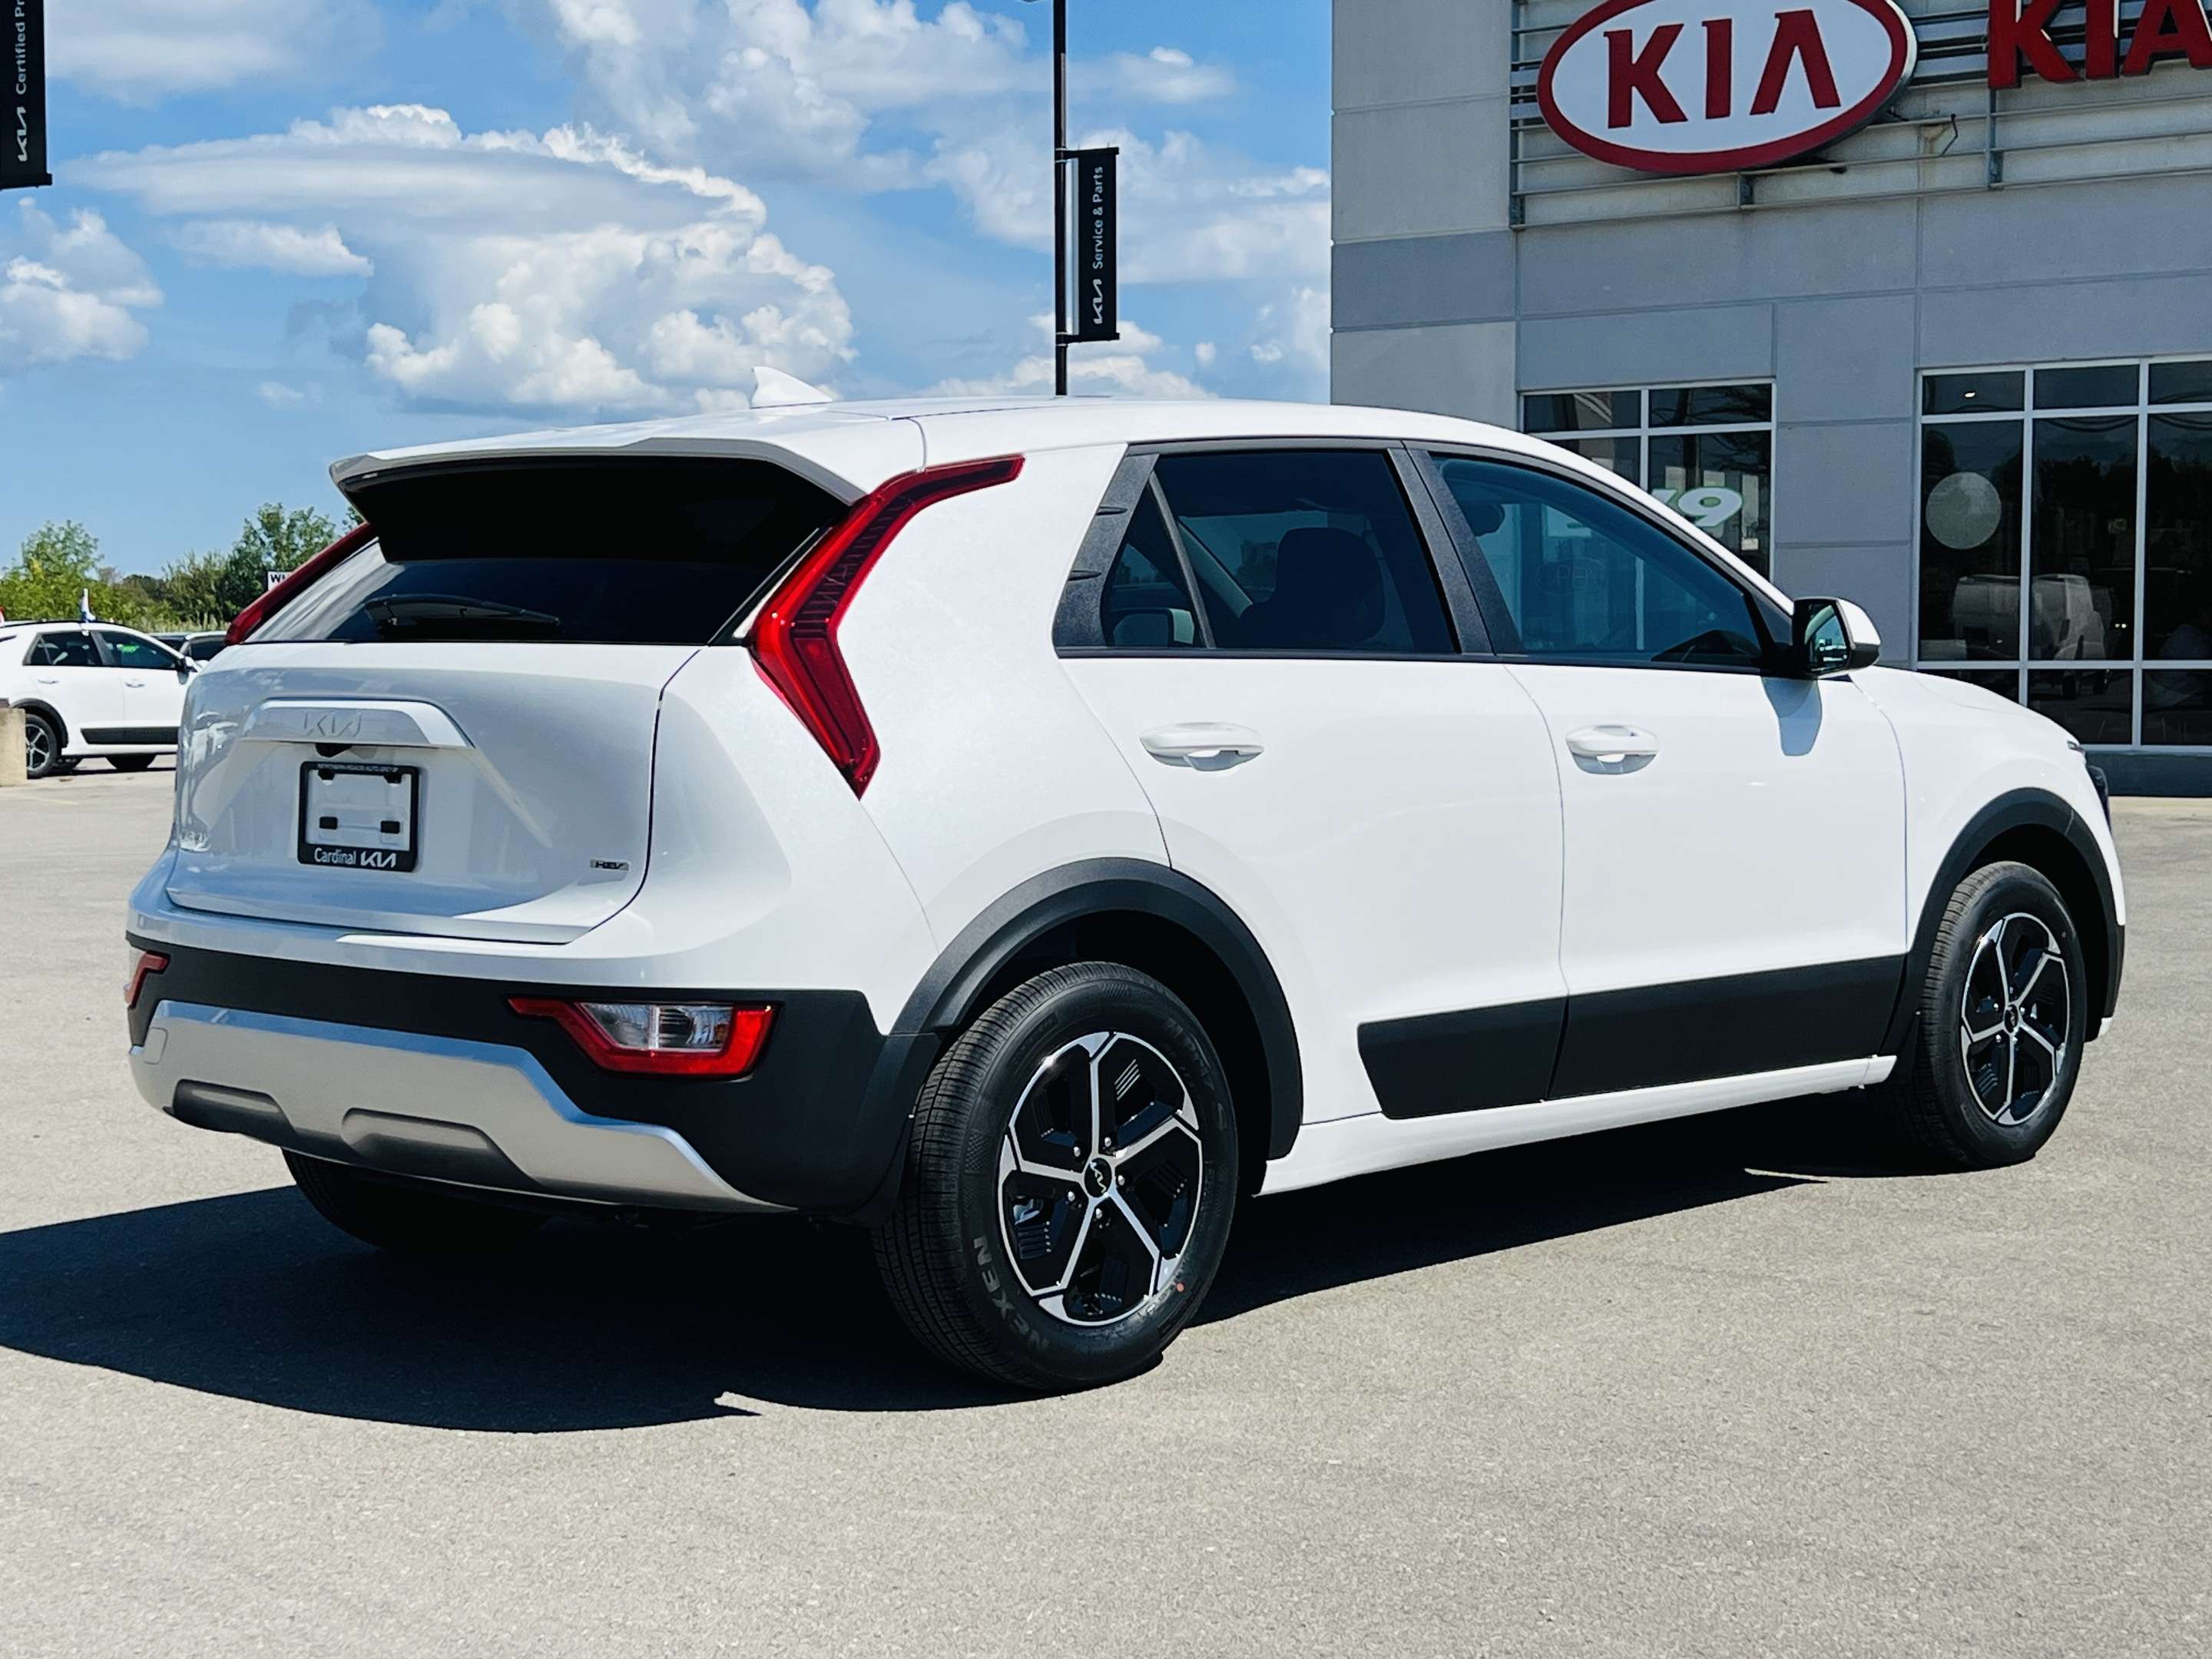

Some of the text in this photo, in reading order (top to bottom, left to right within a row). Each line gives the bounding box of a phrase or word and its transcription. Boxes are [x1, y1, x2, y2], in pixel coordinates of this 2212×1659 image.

[15, 22, 26, 94] Certified
[1603, 9, 1841, 129] KIA
[1988, 0, 2212, 90] KIA
[1093, 167, 1103, 203] Parts
[1093, 207, 1103, 215] &
[1093, 220, 1103, 269] Service
[314, 847, 396, 868] Cardinal KIA
